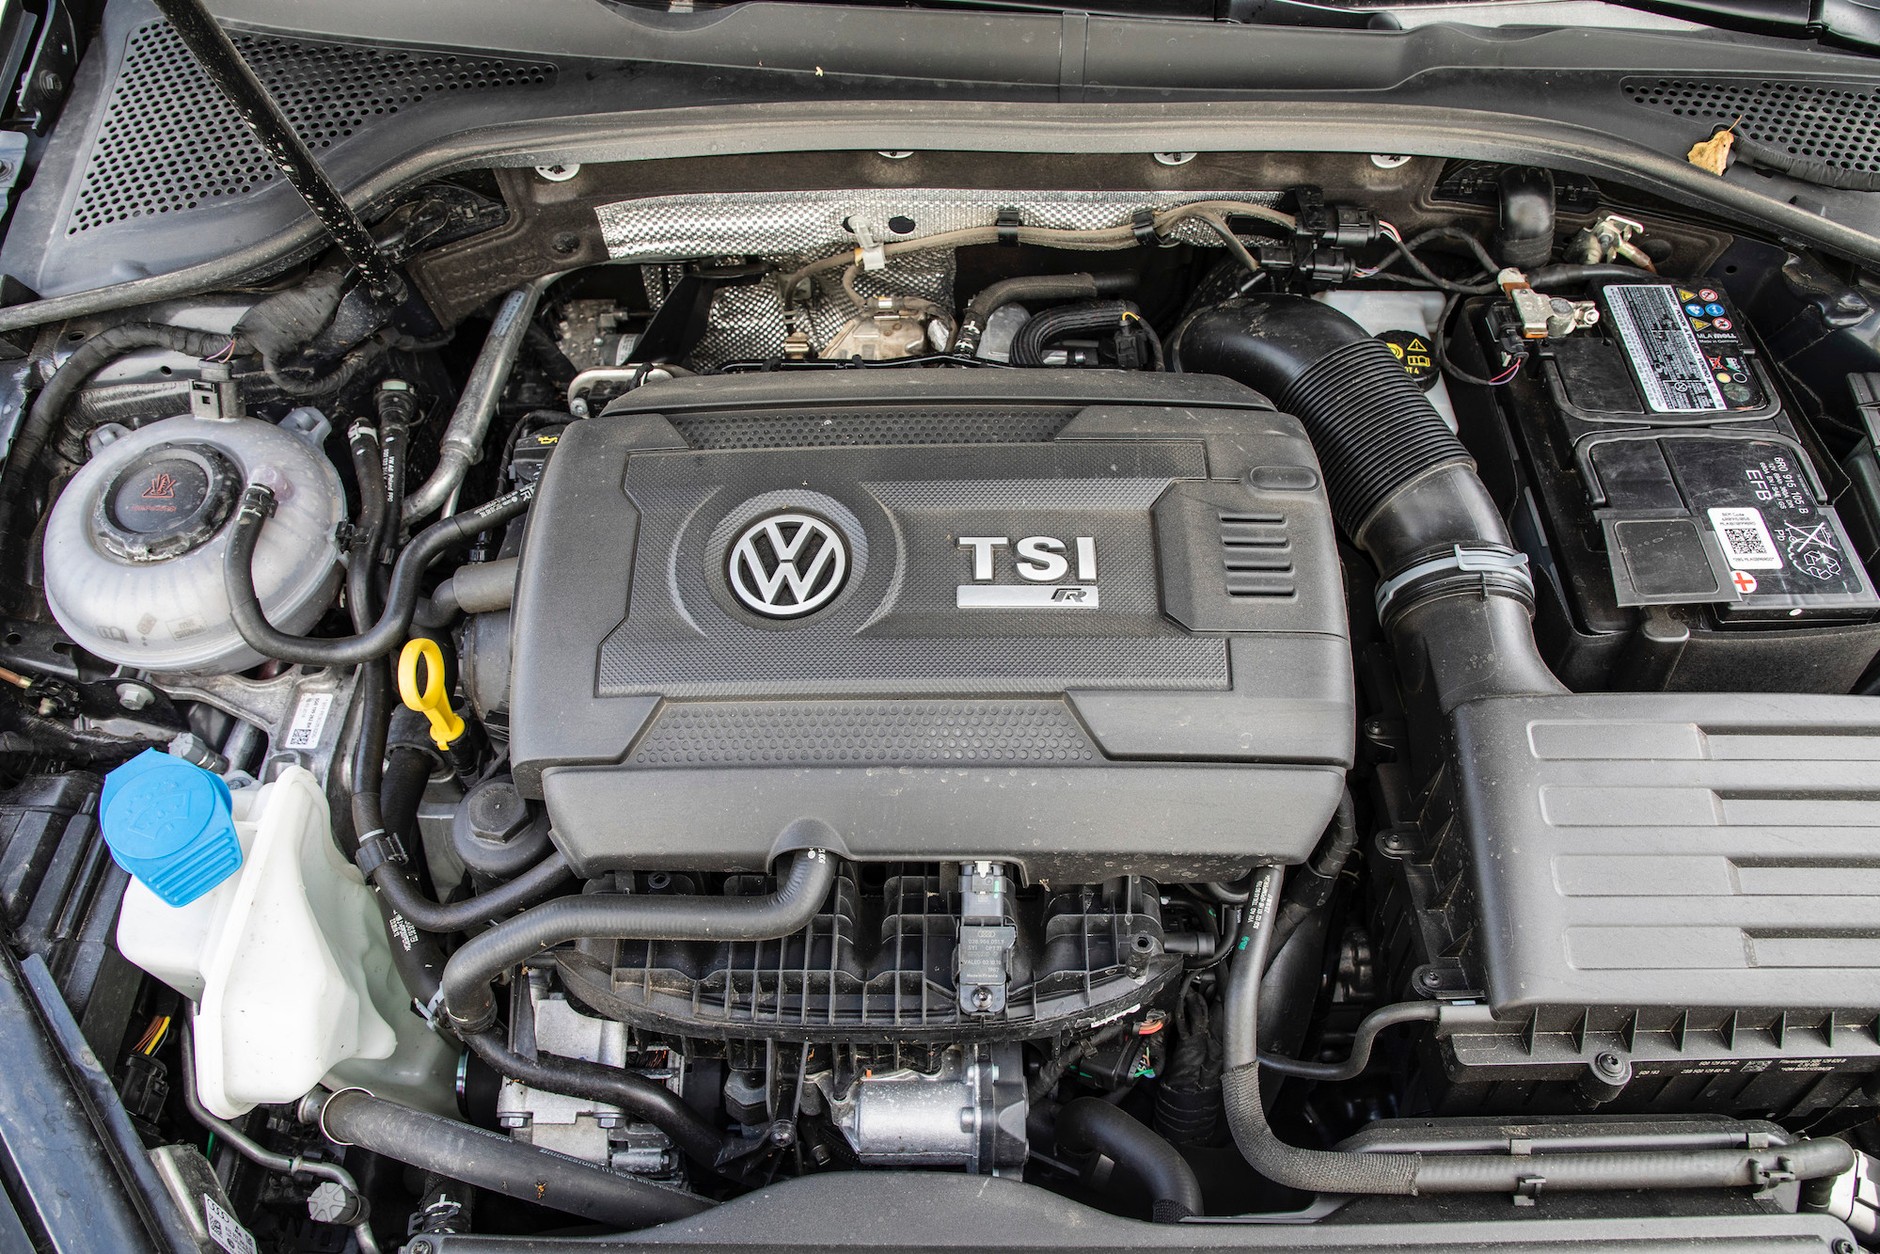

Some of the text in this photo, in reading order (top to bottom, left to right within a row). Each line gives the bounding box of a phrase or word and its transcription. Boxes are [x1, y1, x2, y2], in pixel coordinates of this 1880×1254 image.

[1745, 468, 1773, 502] EFB
[1774, 456, 1789, 472] 6R0
[1782, 474, 1796, 488] 915
[1790, 492, 1805, 506] 105
[1774, 529, 1785, 541] Pb
[958, 536, 1098, 582] TSI
